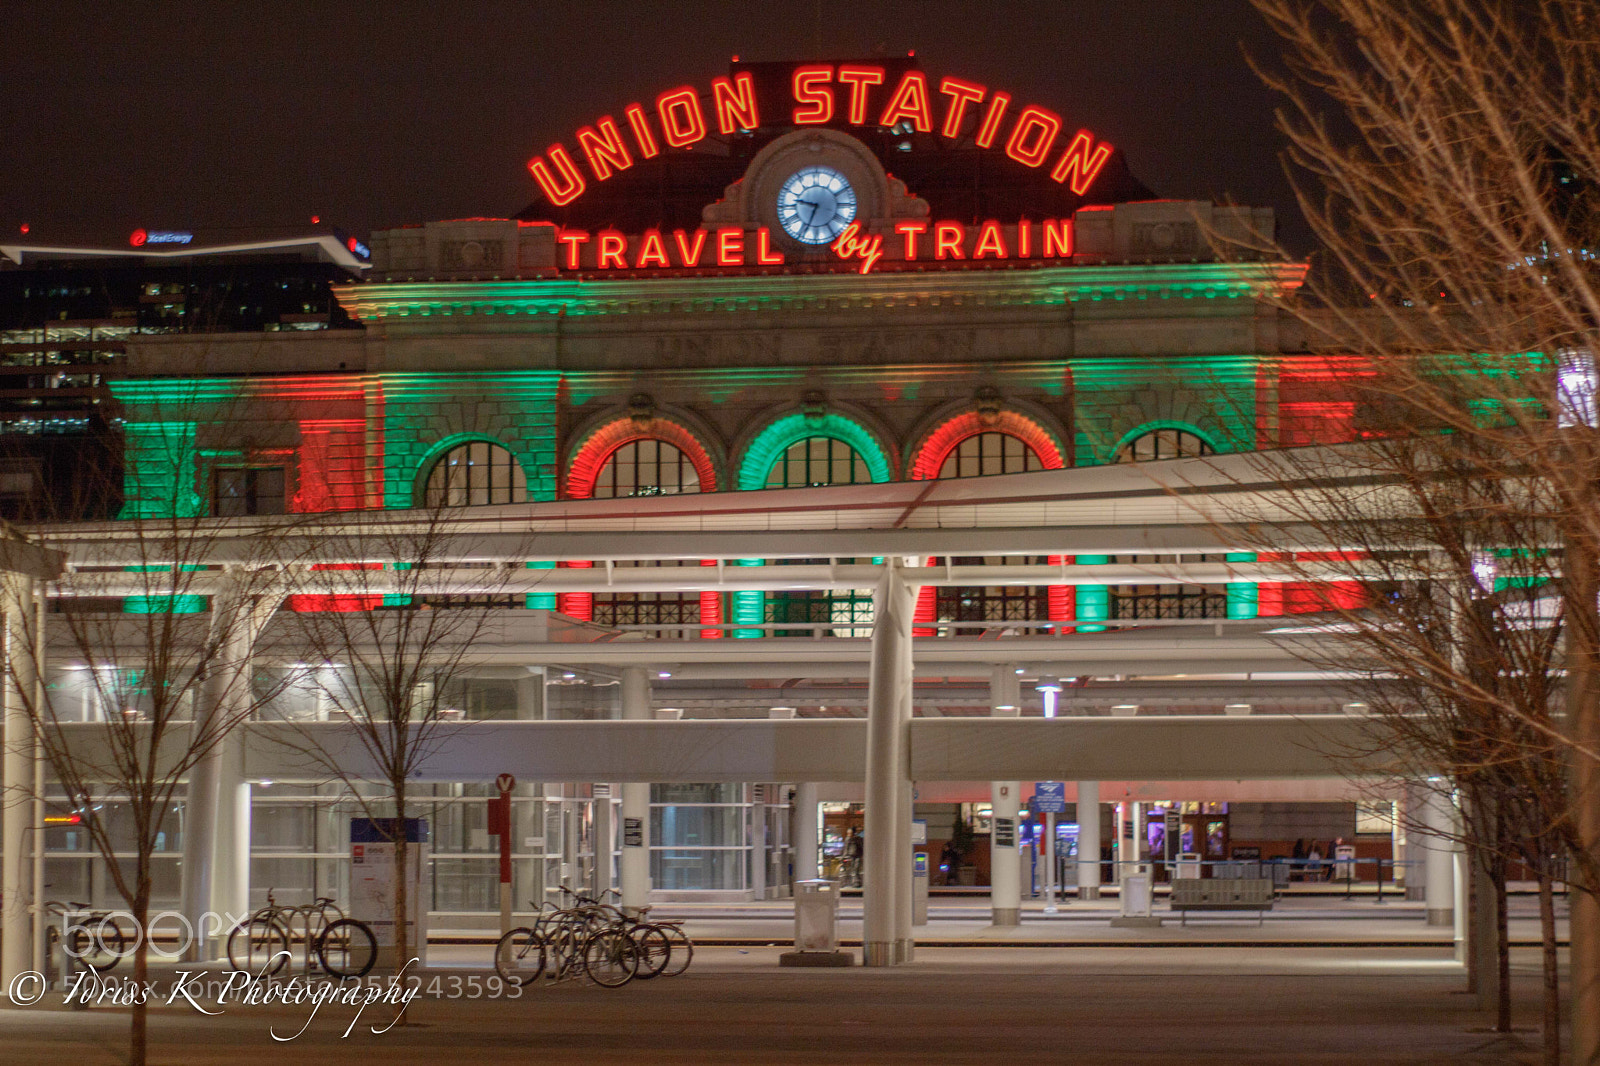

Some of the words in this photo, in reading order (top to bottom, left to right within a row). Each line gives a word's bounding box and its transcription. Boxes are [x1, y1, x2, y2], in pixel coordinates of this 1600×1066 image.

[527, 71, 761, 208] UNION
[791, 63, 1115, 198] STATION
[557, 228, 785, 271] TRAVEL
[831, 219, 883, 276] by
[896, 218, 1074, 262] TRAIN
[498, 775, 512, 792] V
